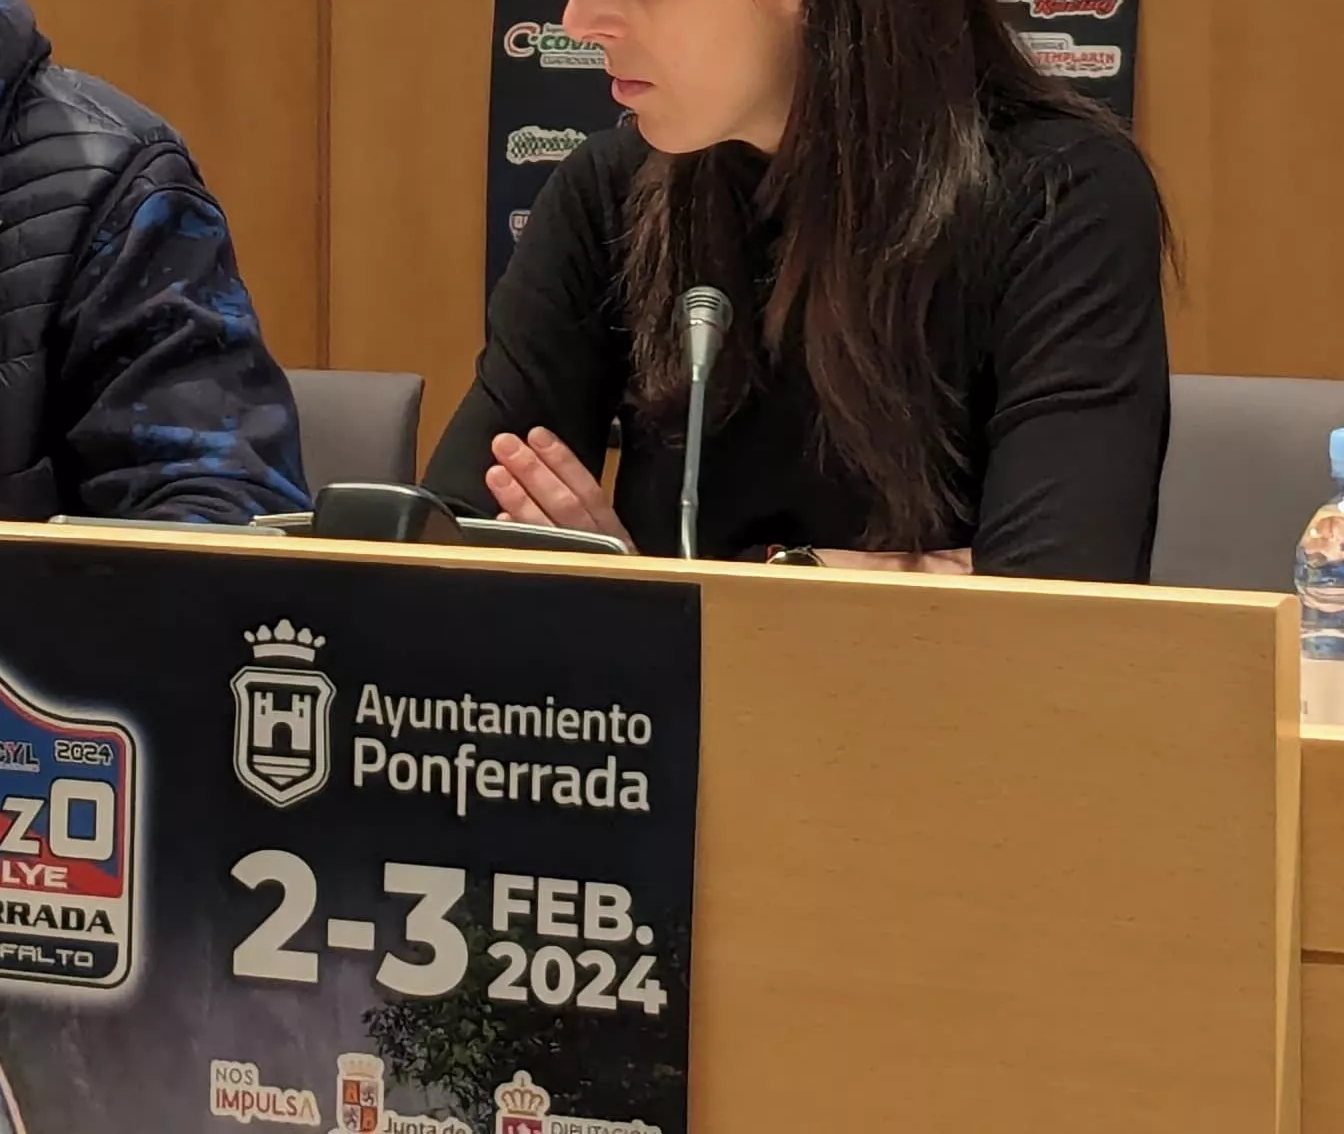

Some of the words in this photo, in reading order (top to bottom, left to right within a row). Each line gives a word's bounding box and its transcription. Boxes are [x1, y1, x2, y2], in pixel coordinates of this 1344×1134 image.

[355, 682, 654, 746] Ayuntamiento
[53, 739, 113, 766] 2024
[353, 736, 652, 817] Ponferrada
[230, 848, 470, 998] 2-3
[491, 871, 655, 947] FEB.
[486, 940, 669, 1016] 2024
[215, 1067, 254, 1086] NOS
[215, 1088, 316, 1118] IMPULSA
